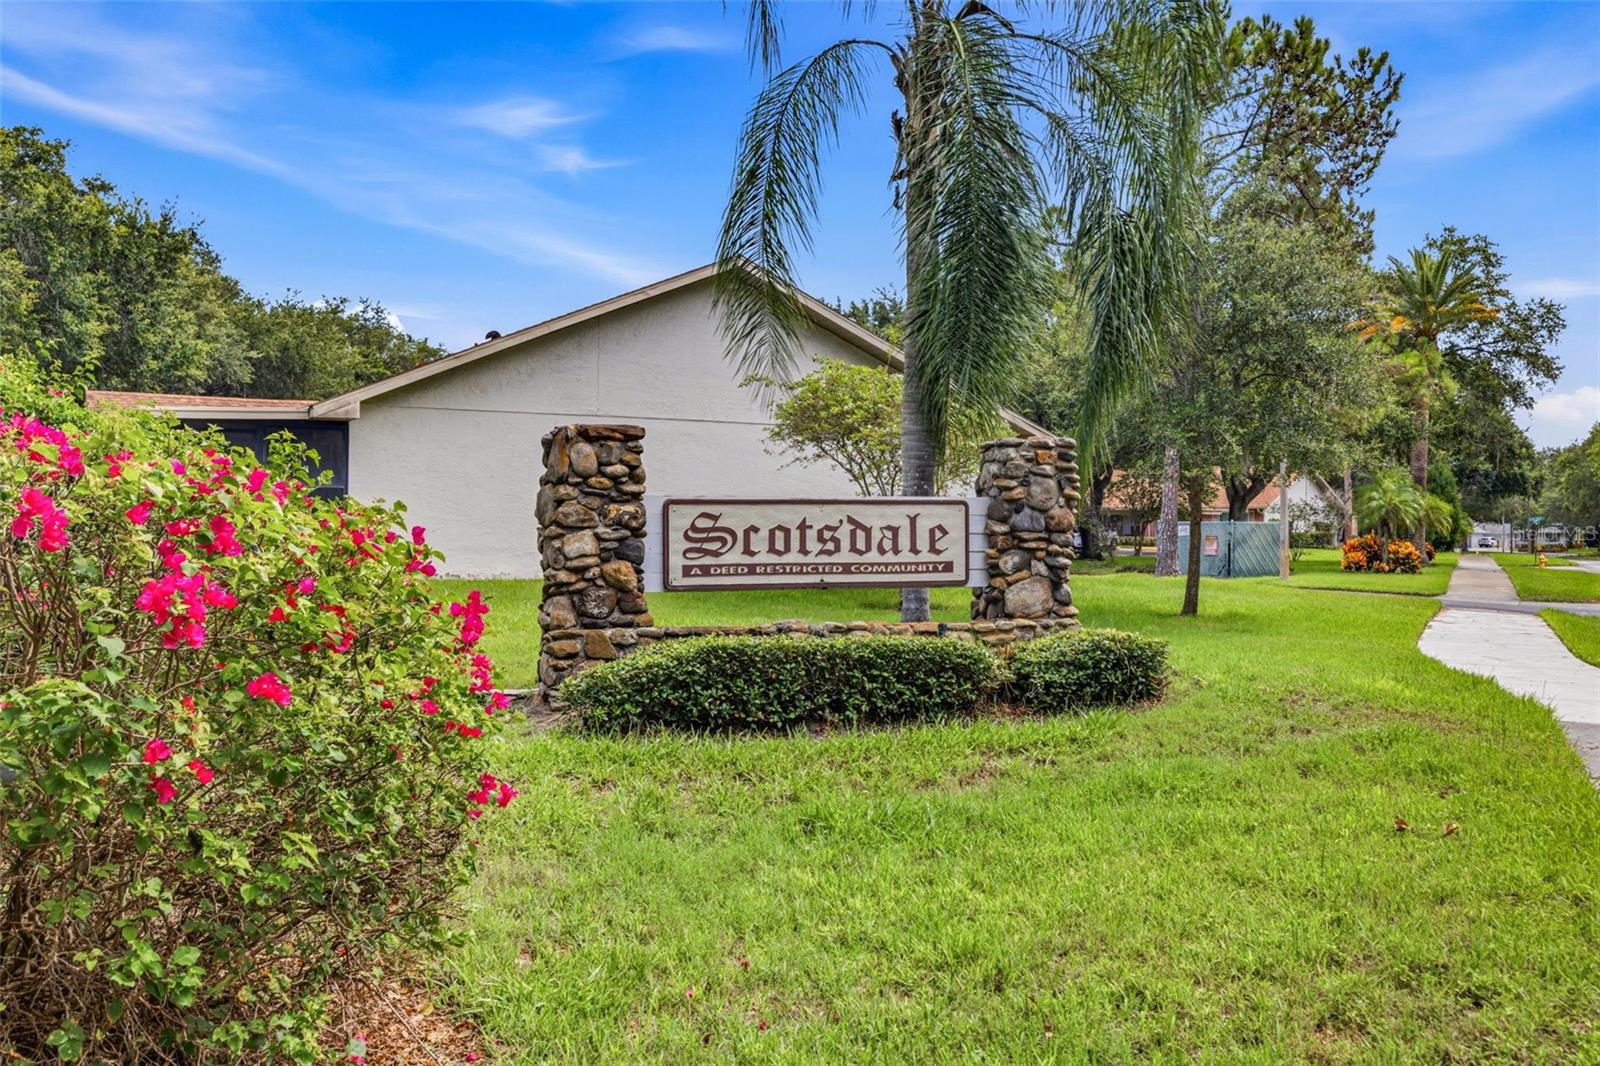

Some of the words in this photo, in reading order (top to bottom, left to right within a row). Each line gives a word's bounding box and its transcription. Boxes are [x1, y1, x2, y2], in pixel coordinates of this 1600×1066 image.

[683, 511, 950, 560] Scotsdale
[690, 567, 703, 575] A
[710, 566, 749, 575] DEED
[756, 564, 843, 574] RESTRICTED
[851, 562, 946, 573] COMMUNITY
